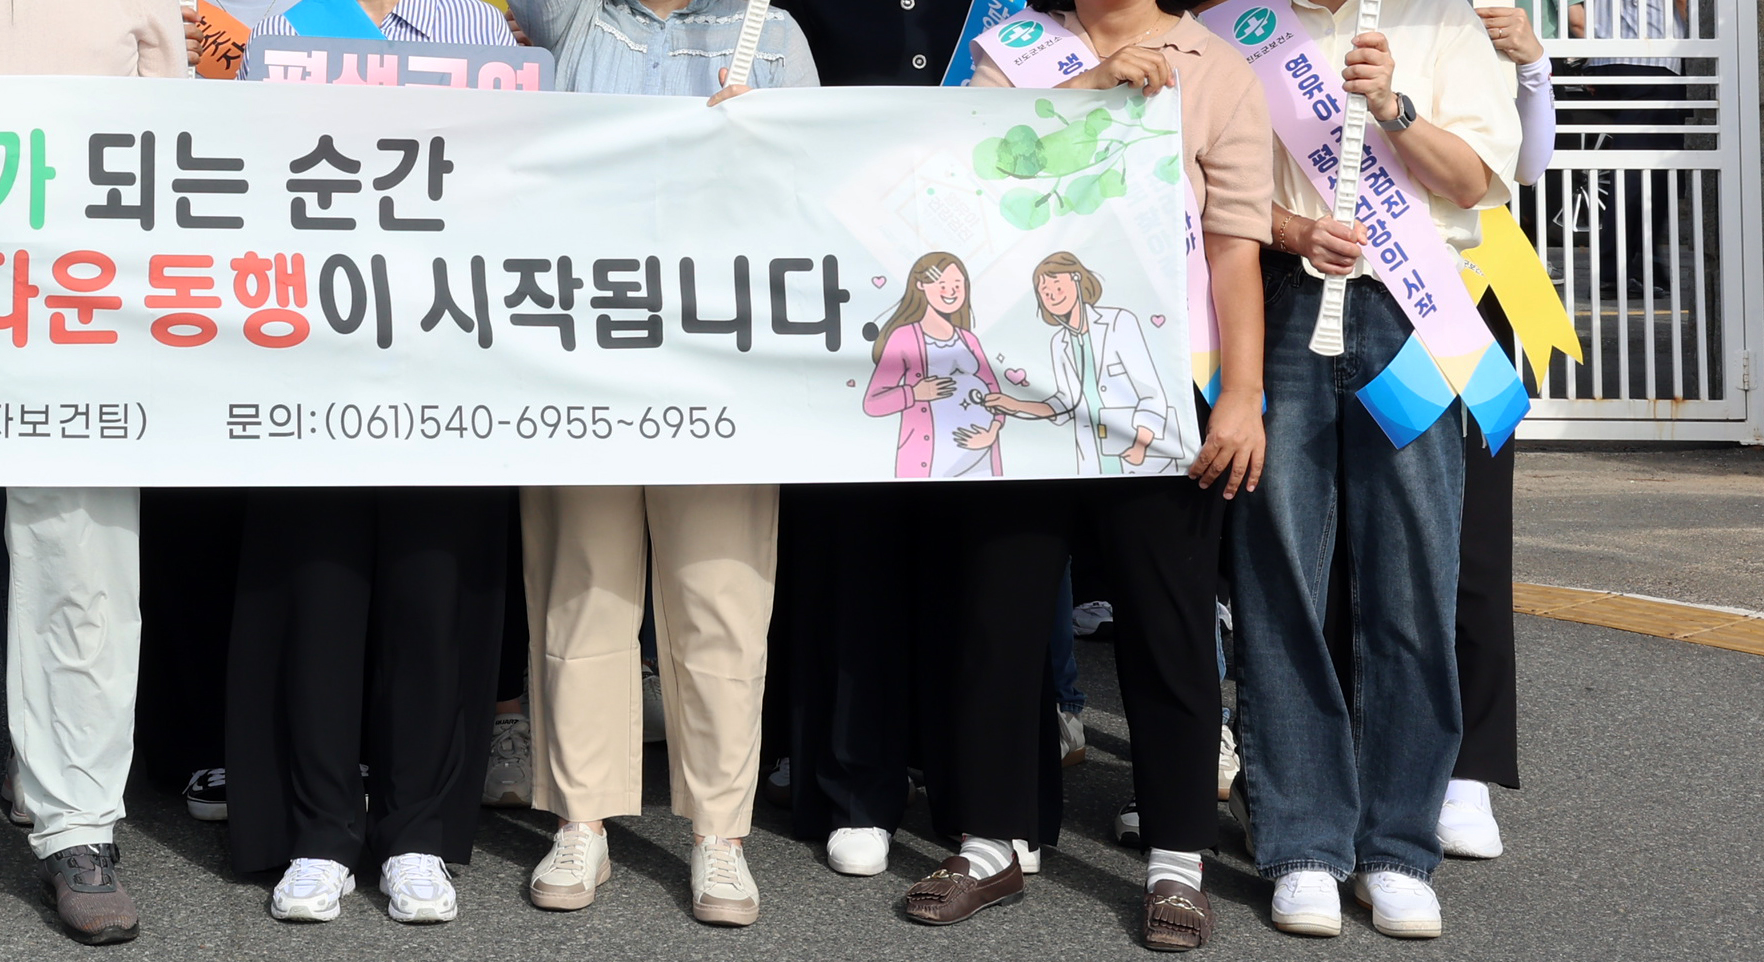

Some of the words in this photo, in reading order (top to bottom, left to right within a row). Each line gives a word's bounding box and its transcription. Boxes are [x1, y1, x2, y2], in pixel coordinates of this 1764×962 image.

[1284, 52, 1342, 121] 영유아
[83, 129, 250, 232] 되는
[286, 134, 454, 233] 순간
[146, 250, 394, 350] 동행이
[420, 253, 881, 353] 시작됩니다.
[1402, 268, 1438, 318] 시작
